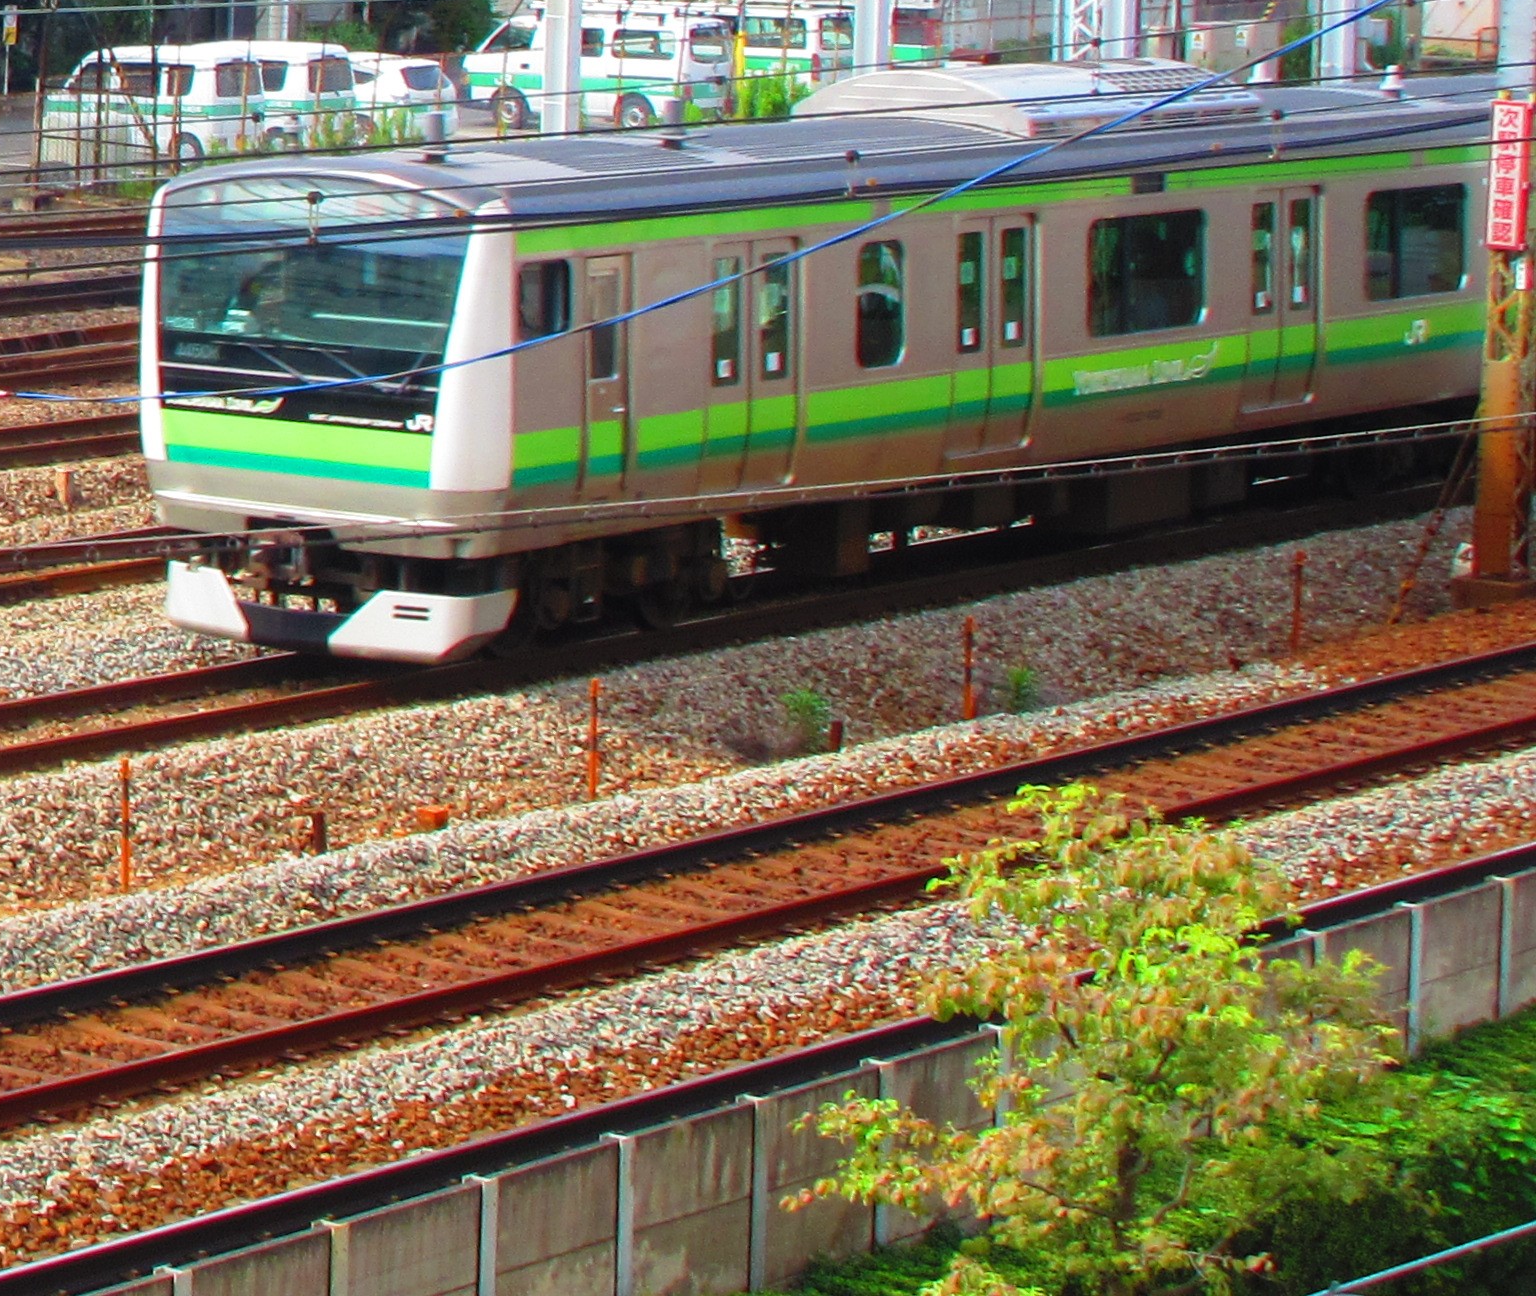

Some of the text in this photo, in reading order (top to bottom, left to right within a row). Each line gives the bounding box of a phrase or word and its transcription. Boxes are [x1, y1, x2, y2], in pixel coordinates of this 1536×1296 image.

[1492, 107, 1520, 243] 次駅停車確認
[405, 413, 434, 432] JR
